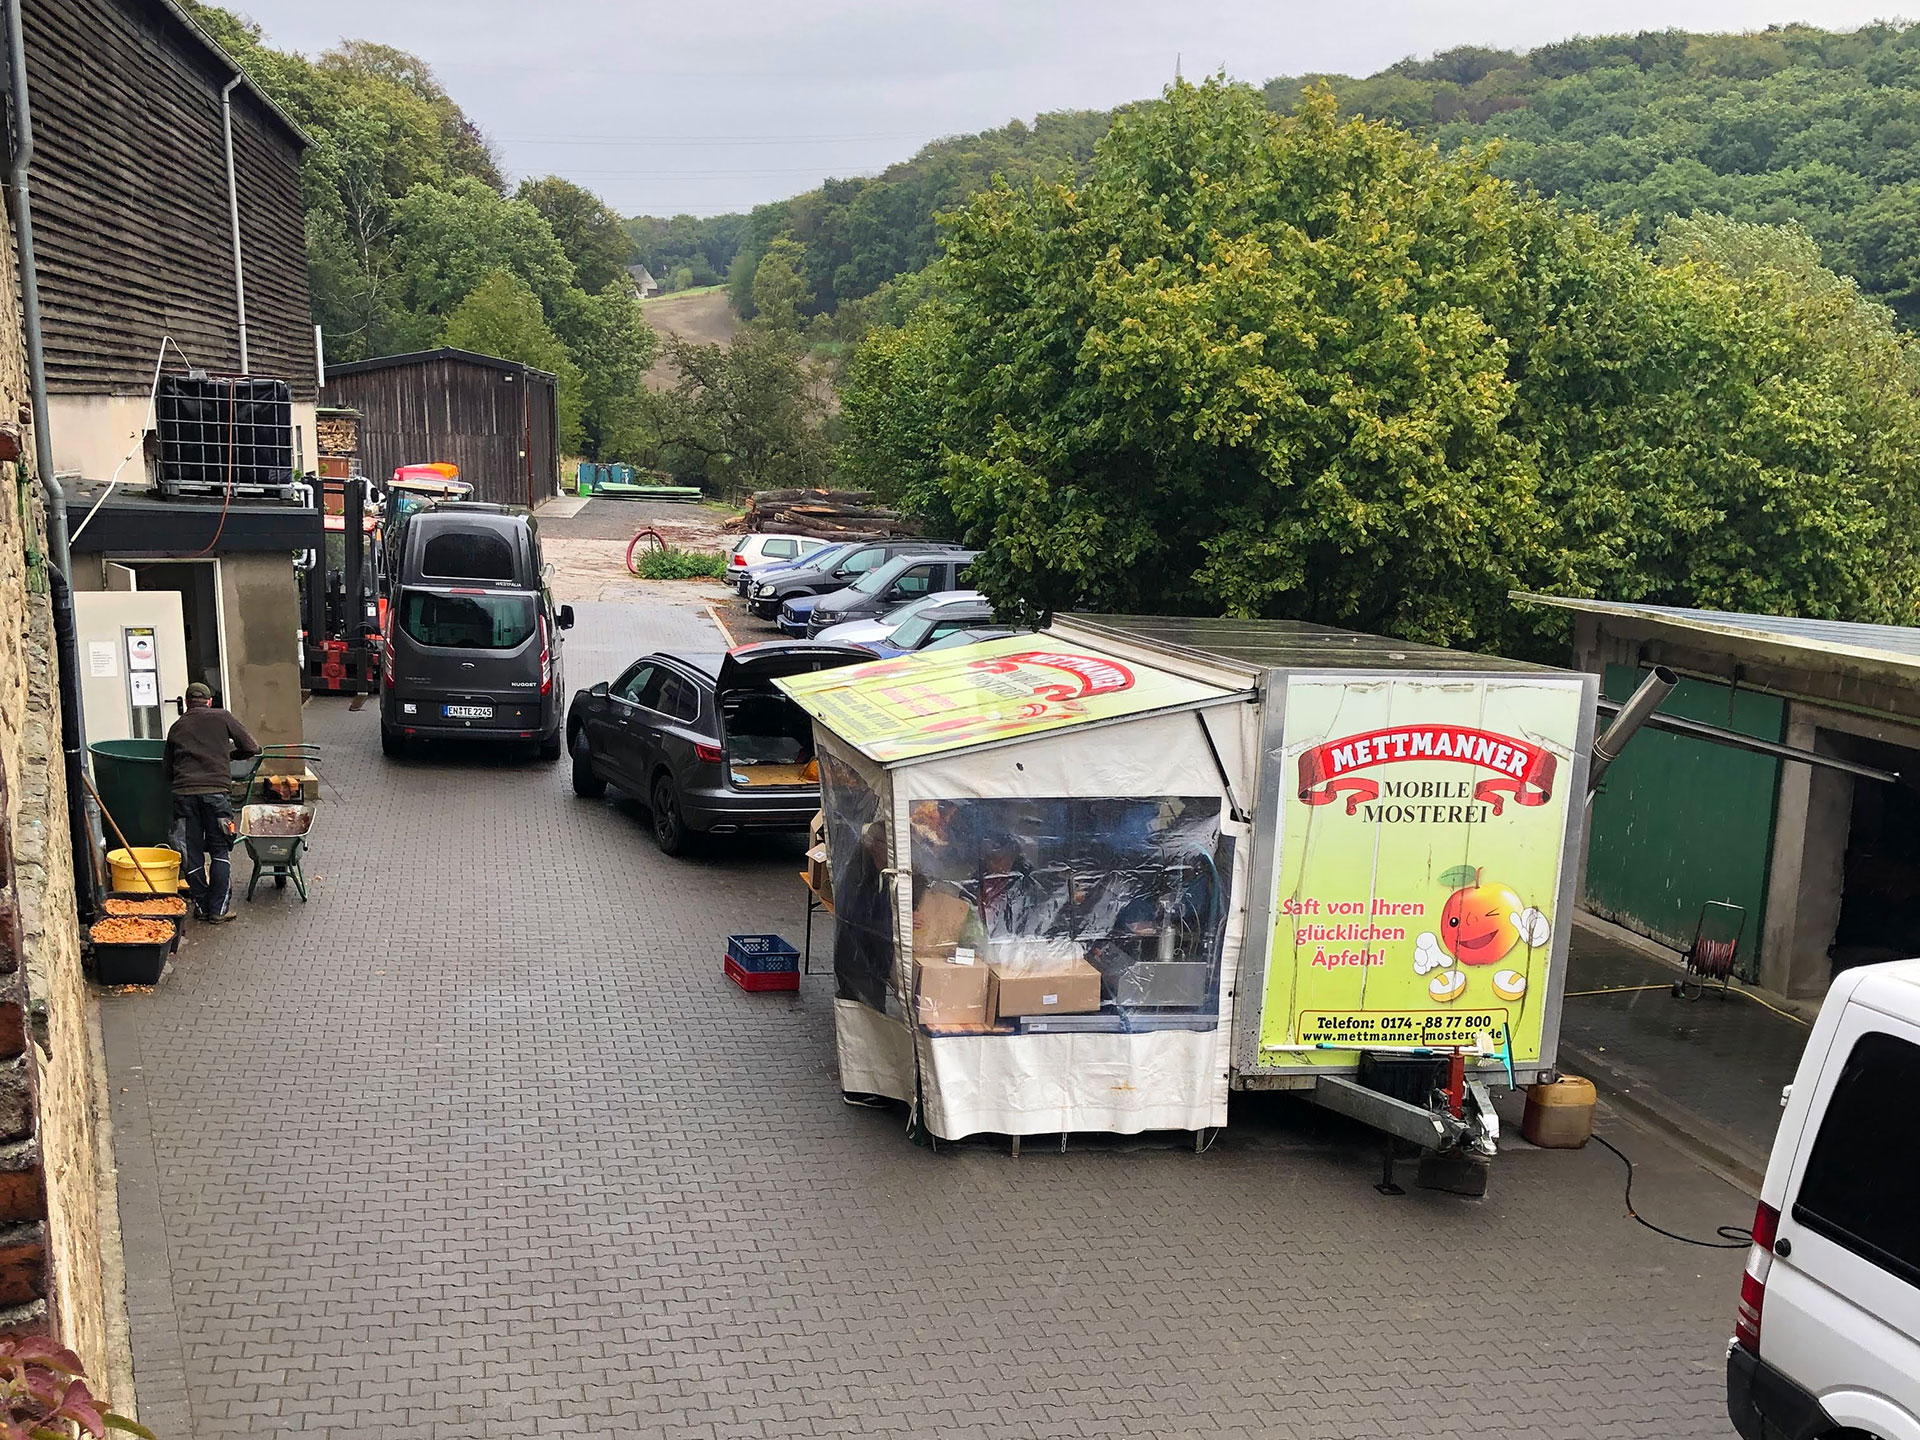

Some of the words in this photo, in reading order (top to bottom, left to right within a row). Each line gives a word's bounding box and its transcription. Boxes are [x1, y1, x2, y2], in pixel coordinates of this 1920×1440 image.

[448, 706, 459, 715] EN
[463, 707, 473, 716] TE
[473, 707, 492, 716] 2245
[1330, 731, 1528, 778] METTMANNER
[1383, 781, 1471, 798] MOBILE
[1362, 804, 1488, 824] MOSTEREI
[1282, 898, 1320, 915] Saft
[1327, 902, 1365, 915] von
[1371, 899, 1425, 915] Ihren
[1296, 924, 1405, 945] glücklichen
[1311, 946, 1385, 971] Äpfeln!
[1317, 1016, 1375, 1029] Telefon:
[1381, 1016, 1412, 1029] 0174
[1425, 1016, 1443, 1028] 88
[1446, 1016, 1462, 1028] 77
[1465, 1015, 1492, 1028] 800
